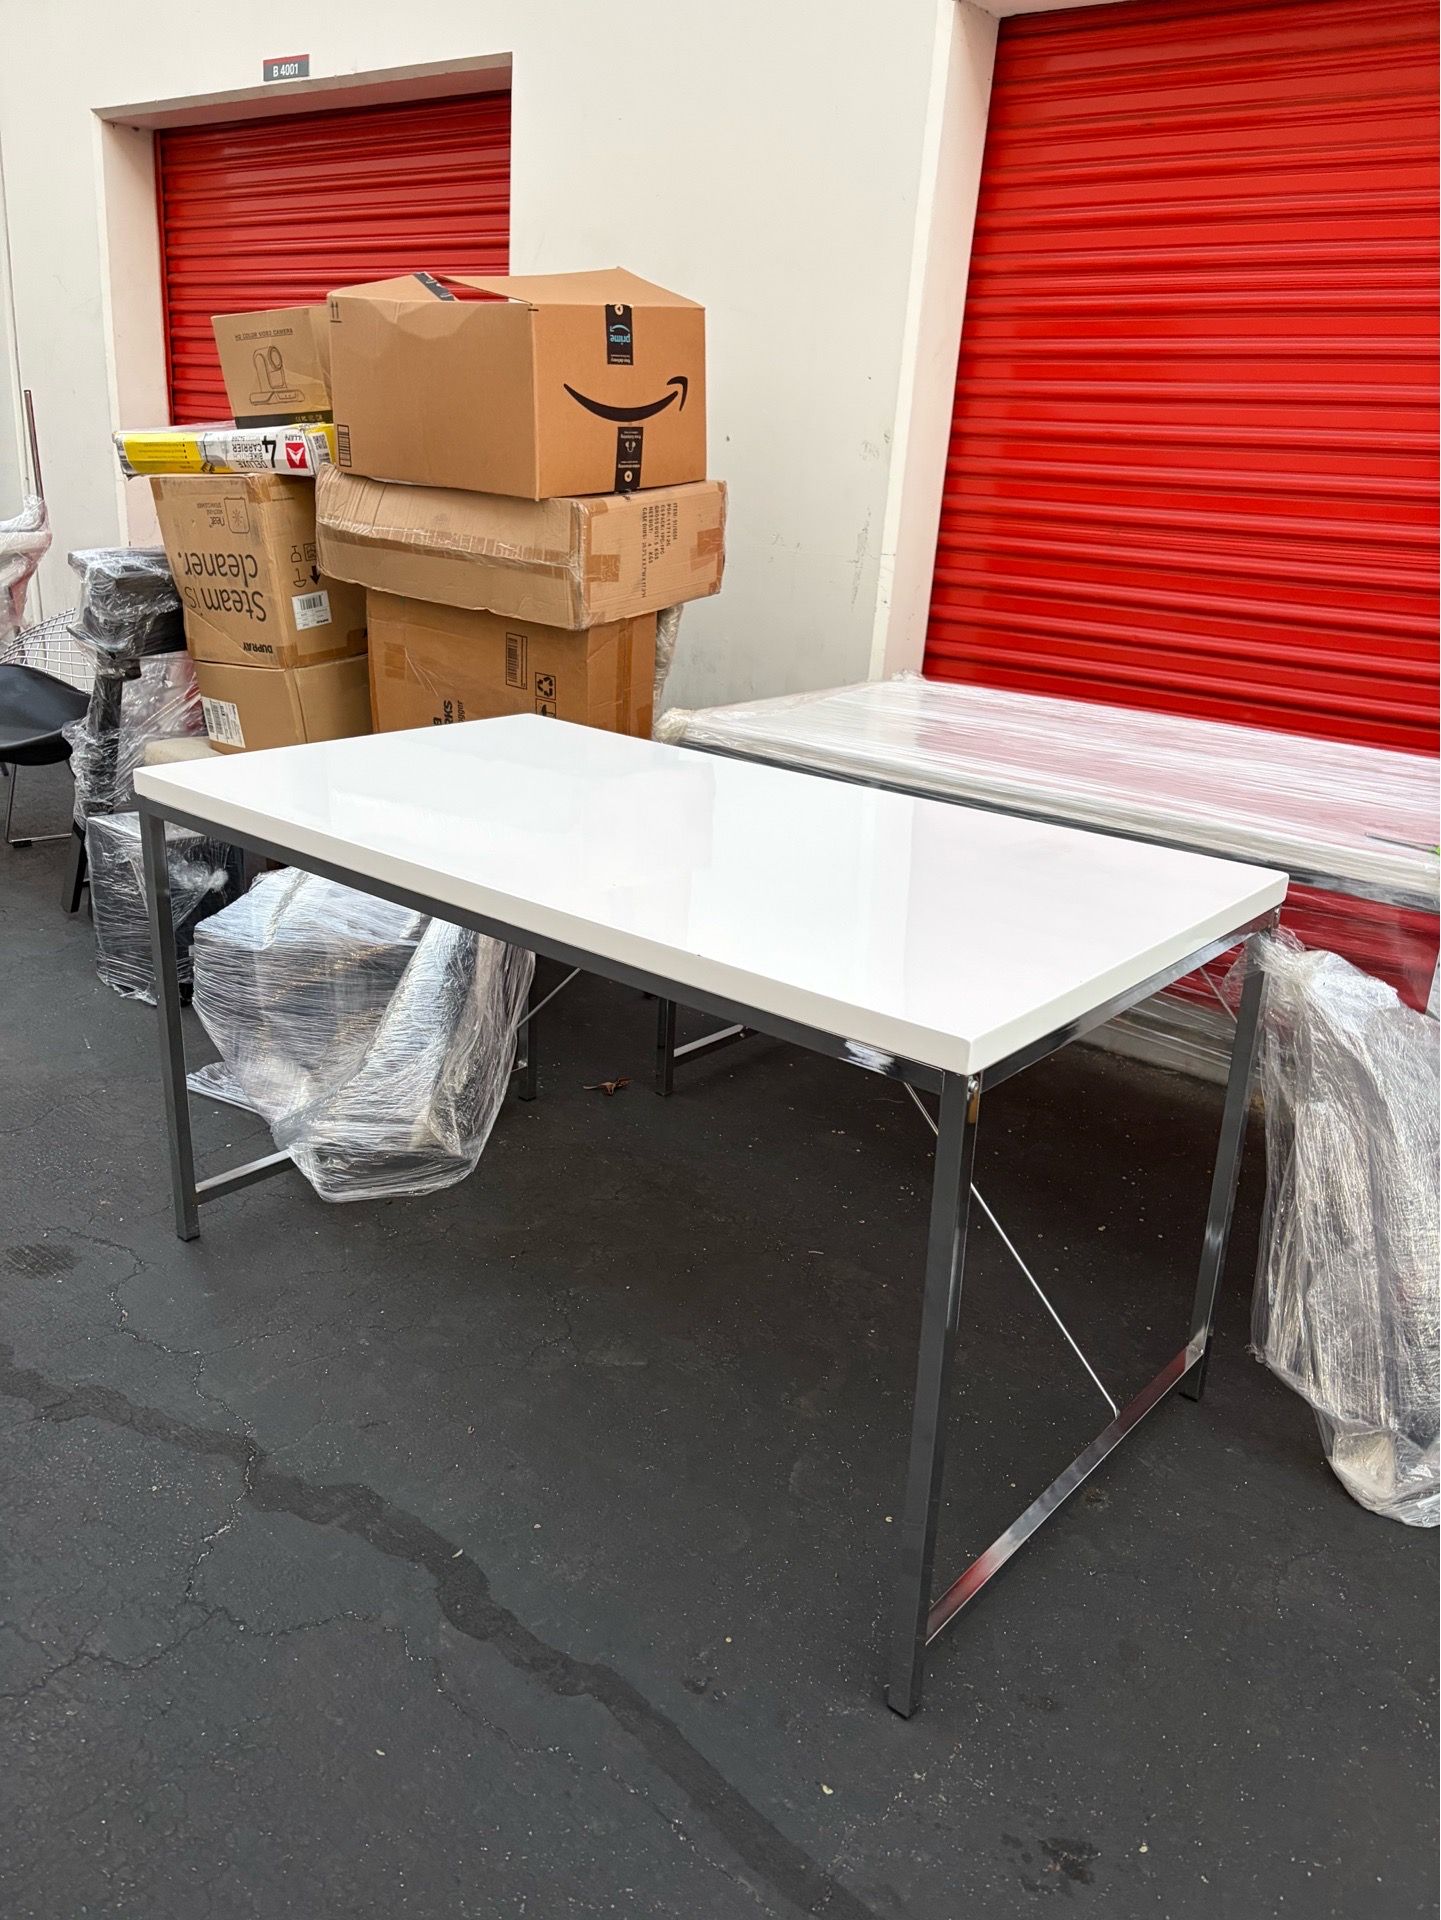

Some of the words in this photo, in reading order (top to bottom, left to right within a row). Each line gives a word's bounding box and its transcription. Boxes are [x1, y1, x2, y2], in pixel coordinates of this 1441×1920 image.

[272, 65, 279, 77] B
[280, 63, 299, 76] 4001
[272, 327, 293, 337] CAMERA
[610, 333, 631, 345] prime
[231, 443, 263, 453] CARRIER
[261, 435, 277, 468] 4
[236, 460, 268, 469] DELUXE
[177, 552, 258, 587] cleaner.
[184, 586, 204, 616] is
[200, 587, 267, 622] Steam
[243, 642, 273, 654] DUPRAY
[443, 699, 454, 725] RKS
